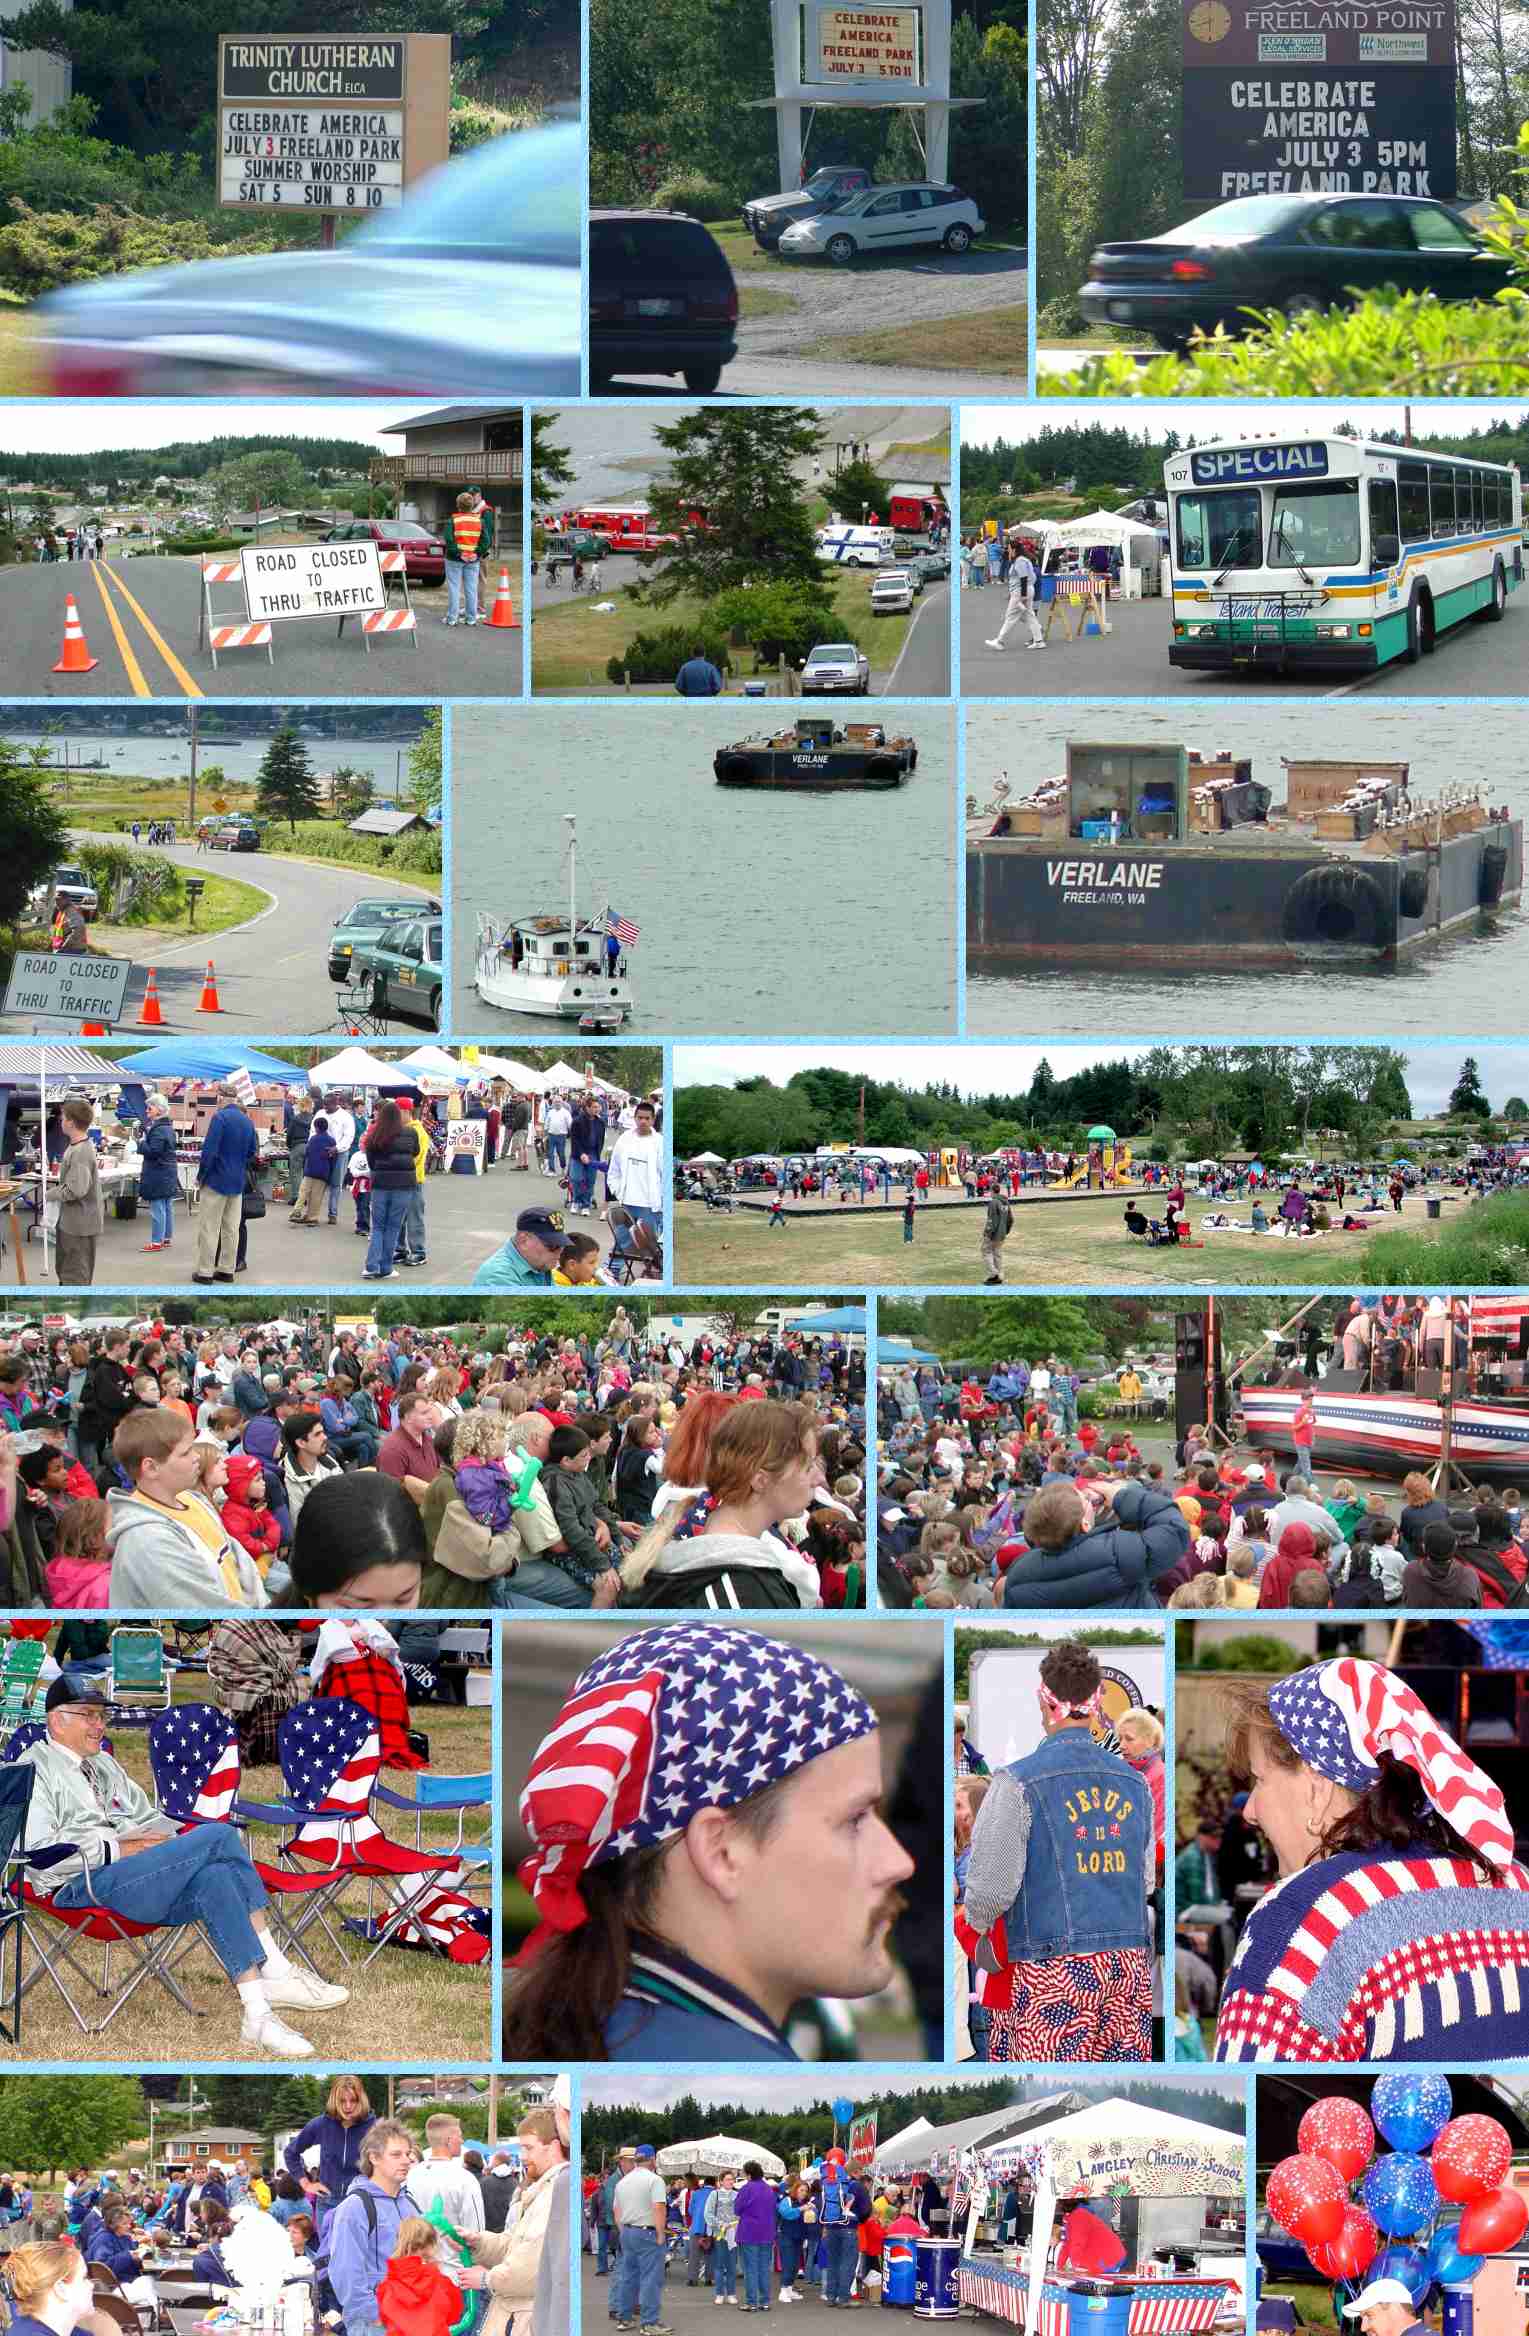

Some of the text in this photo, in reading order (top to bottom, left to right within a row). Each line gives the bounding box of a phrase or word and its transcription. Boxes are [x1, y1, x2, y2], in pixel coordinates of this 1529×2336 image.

[834, 12, 900, 27] CELEBRATE
[1244, 11, 1446, 32] FREELAND POINT
[840, 30, 893, 43] AMERICA
[230, 45, 395, 68] TRINITY LUTHERAN
[823, 46, 913, 60] FREELAND PARK
[828, 62, 855, 74] JULY
[268, 71, 368, 94] CHURCH ELCA
[1230, 80, 1377, 109] CELEBRATE
[228, 112, 388, 136] CELEBRATE AMERICA
[1263, 110, 1370, 138] AMERICA
[224, 136, 400, 160] JULY 3 FREELAND PARK
[1276, 140, 1427, 168] JULY 3 5PM
[244, 160, 377, 183] SUMMER WORSHIP
[239, 183, 382, 207] SAT 5 SUN 8 10
[1220, 170, 1432, 197] FREELAND PARK
[1197, 445, 1325, 479] SPECIAL
[1170, 470, 1188, 481] 107
[256, 549, 367, 572] ROAD CLOSED
[306, 573, 322, 587] TO
[259, 587, 375, 613] THRU TRAFFIC
[1046, 861, 1164, 888] VERLANE
[1063, 891, 1145, 905] FREELAND, WA
[24, 959, 119, 979] ROAD CLOSED
[59, 980, 72, 992] TO
[15, 992, 113, 1015] THRU TRAFFIC
[1064, 1786, 1133, 1823] JESUS
[1076, 1850, 1127, 1873] LORD
[1076, 2149, 1243, 2182] LANGLEY CHRISTIAN SCHOOL
[882, 2245, 891, 2293] PEPSI
